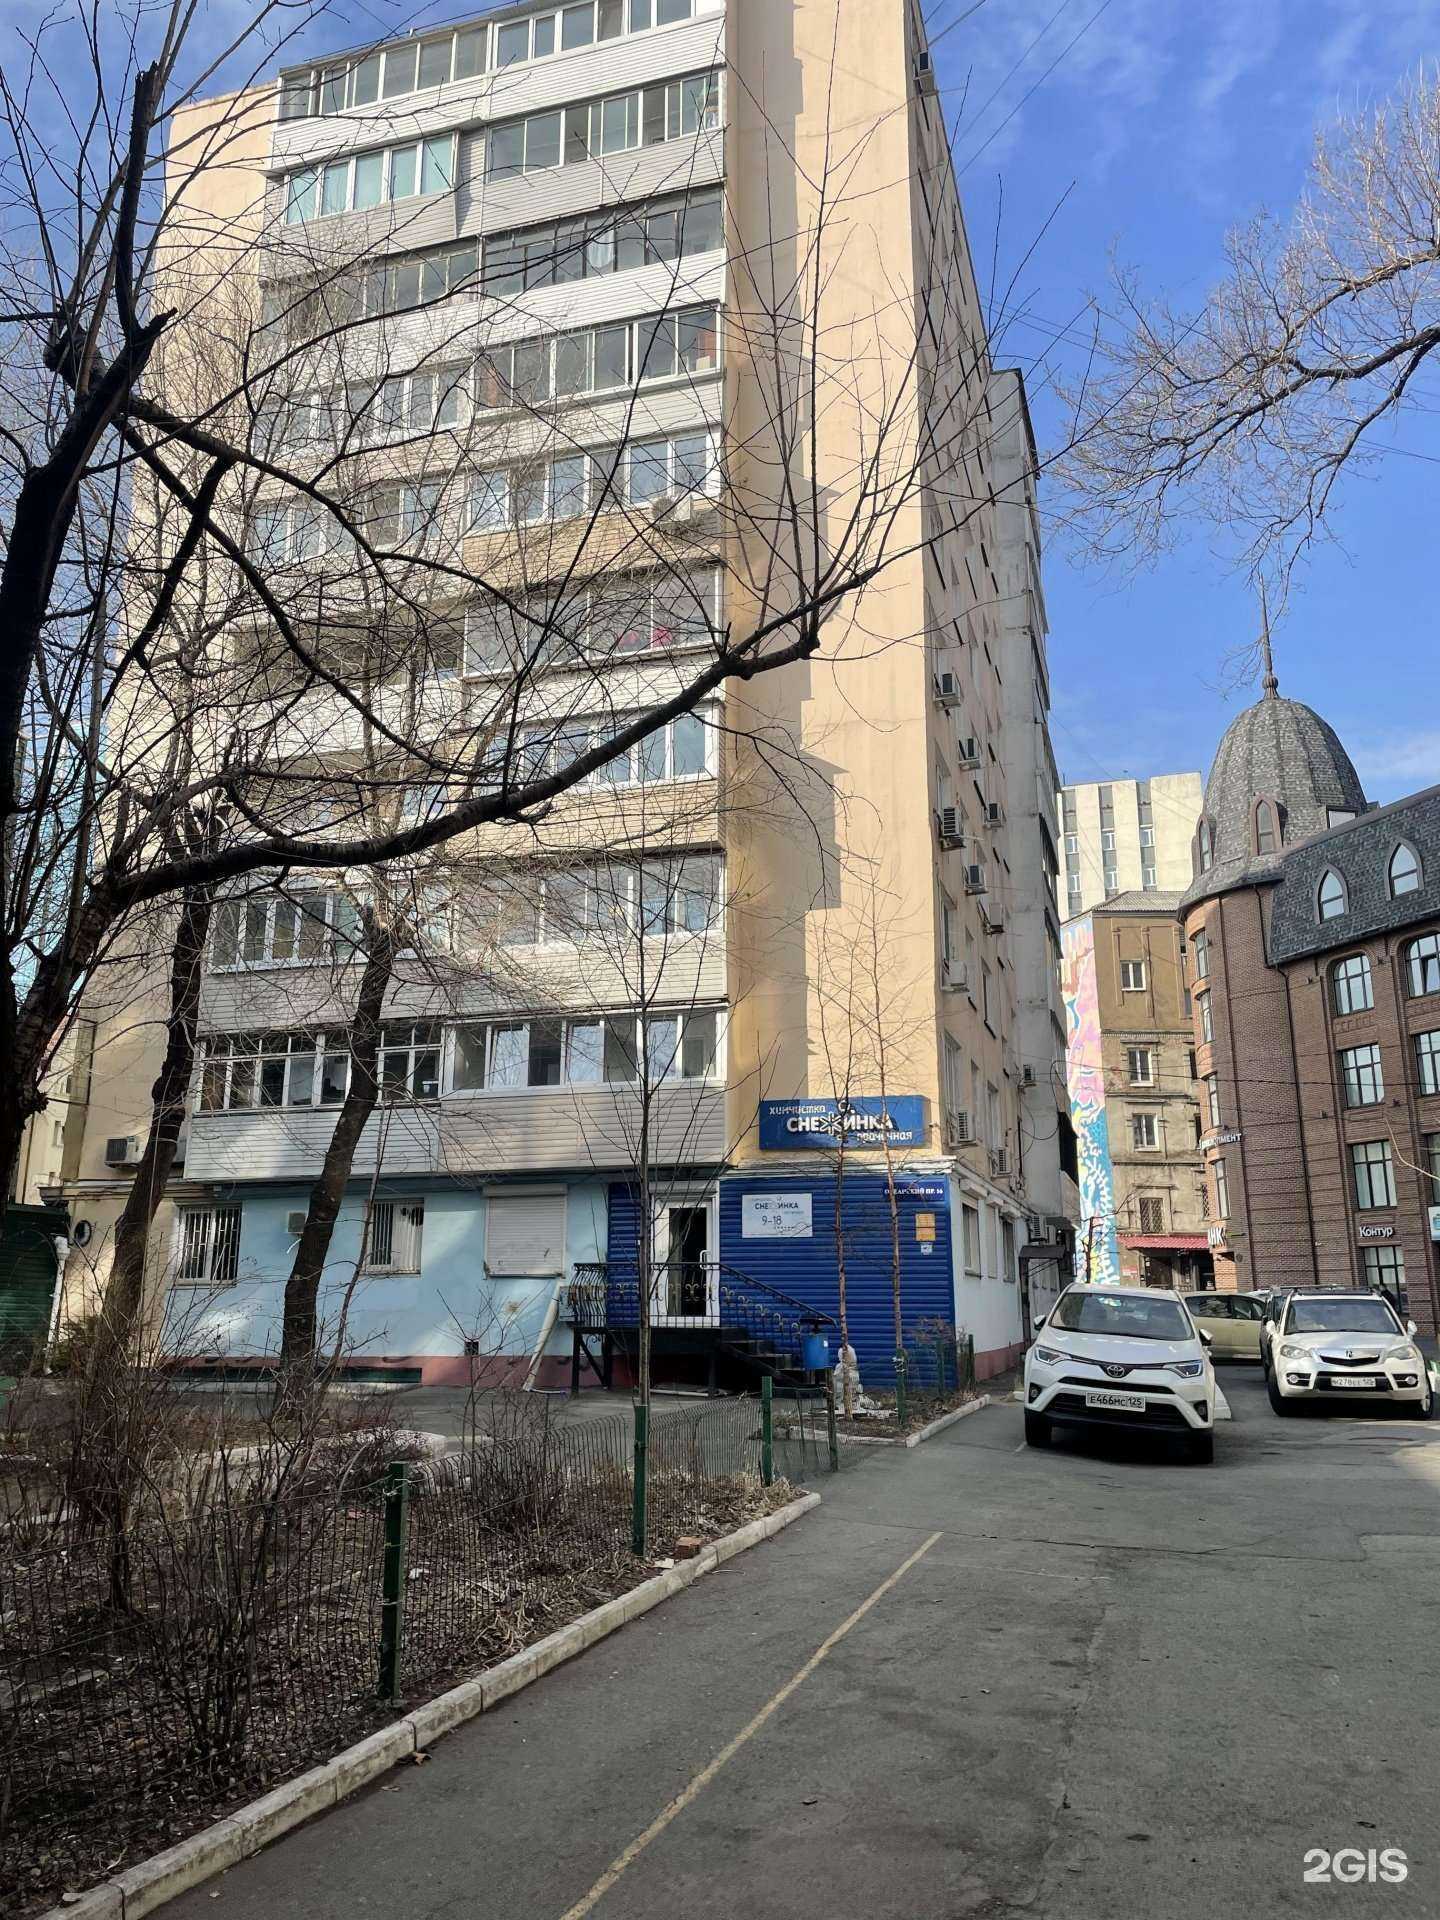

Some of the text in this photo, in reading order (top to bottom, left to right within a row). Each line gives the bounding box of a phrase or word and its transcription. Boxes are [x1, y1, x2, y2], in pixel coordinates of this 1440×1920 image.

[755, 1202, 799, 1210] СНЕИНКА
[762, 1215, 782, 1226] 9-18
[1360, 1226, 1393, 1238] Контур
